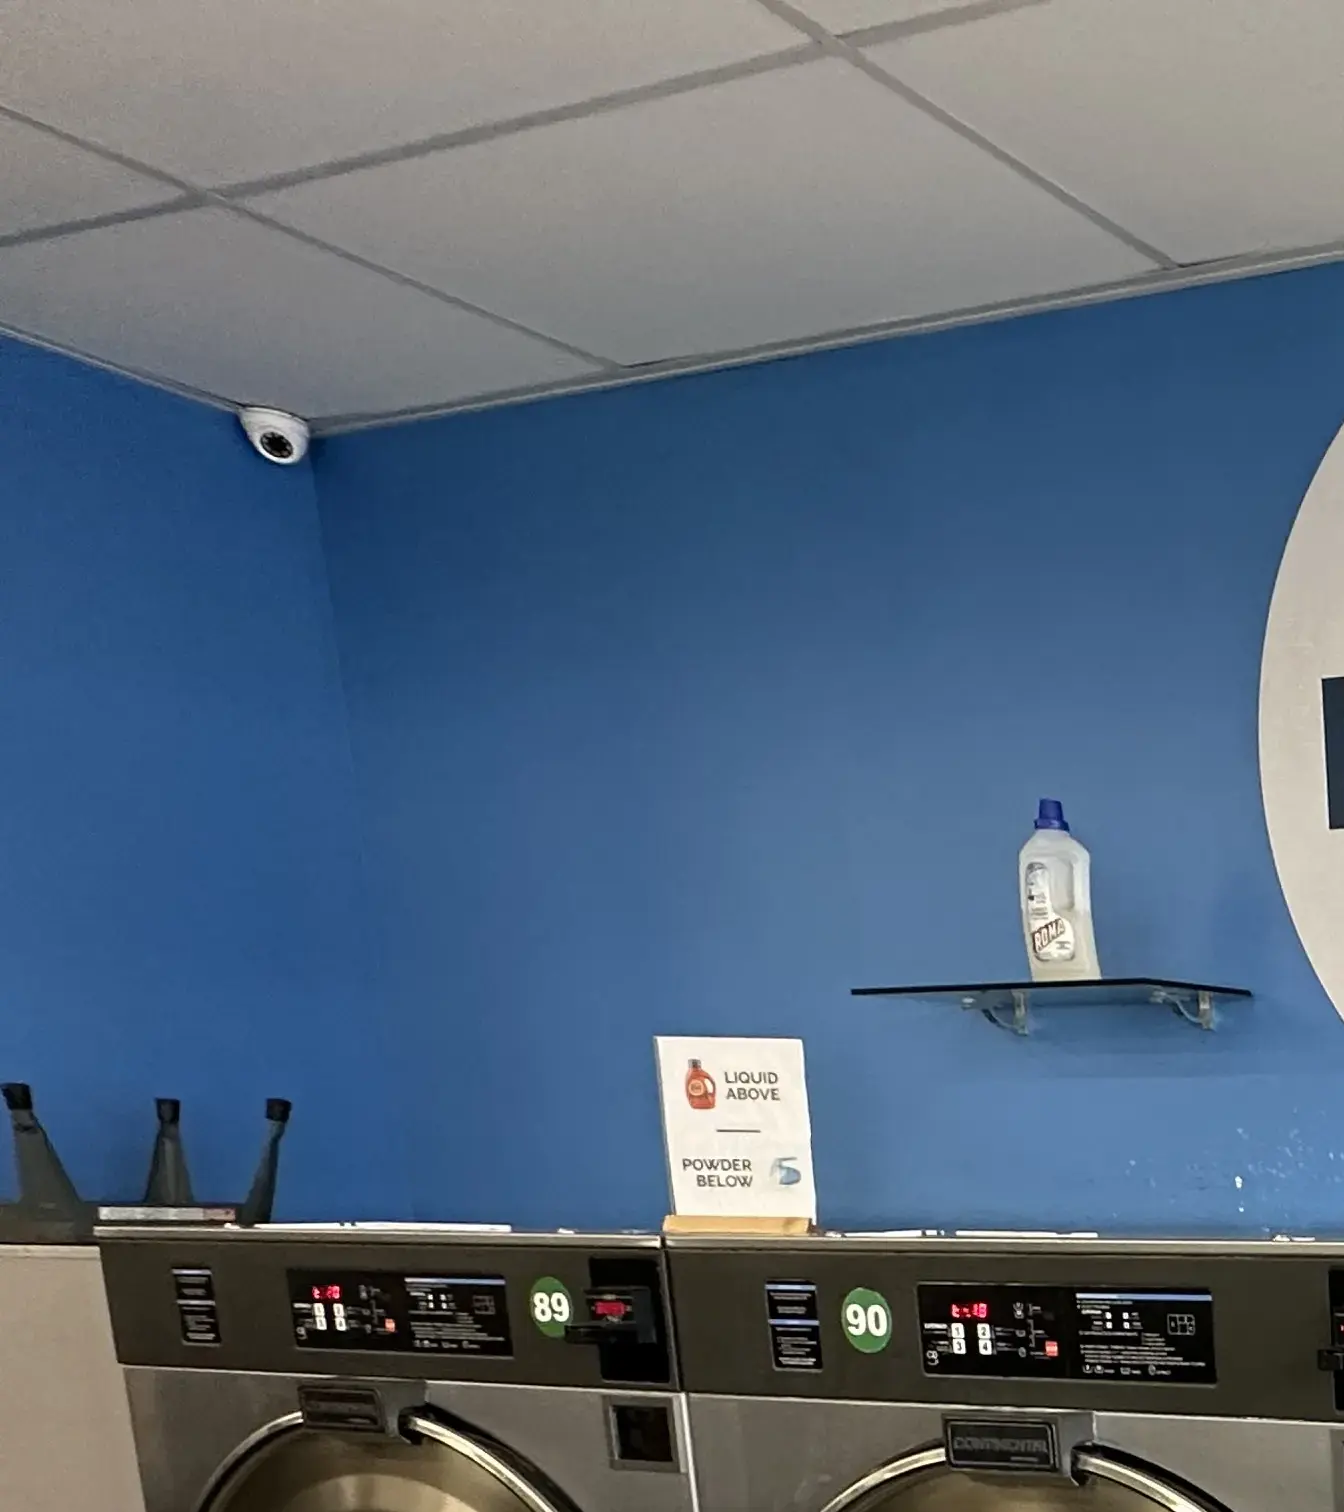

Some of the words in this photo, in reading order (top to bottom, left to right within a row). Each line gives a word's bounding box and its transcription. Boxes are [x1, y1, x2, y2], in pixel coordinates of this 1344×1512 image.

[1033, 918, 1065, 953] ROMA
[724, 1071, 778, 1084] LIQUID
[726, 1088, 780, 1101] ABOVE
[682, 1158, 752, 1171] POWDER
[696, 1174, 753, 1187] BELOW
[533, 1292, 570, 1322] 89
[846, 1304, 887, 1336] 90
